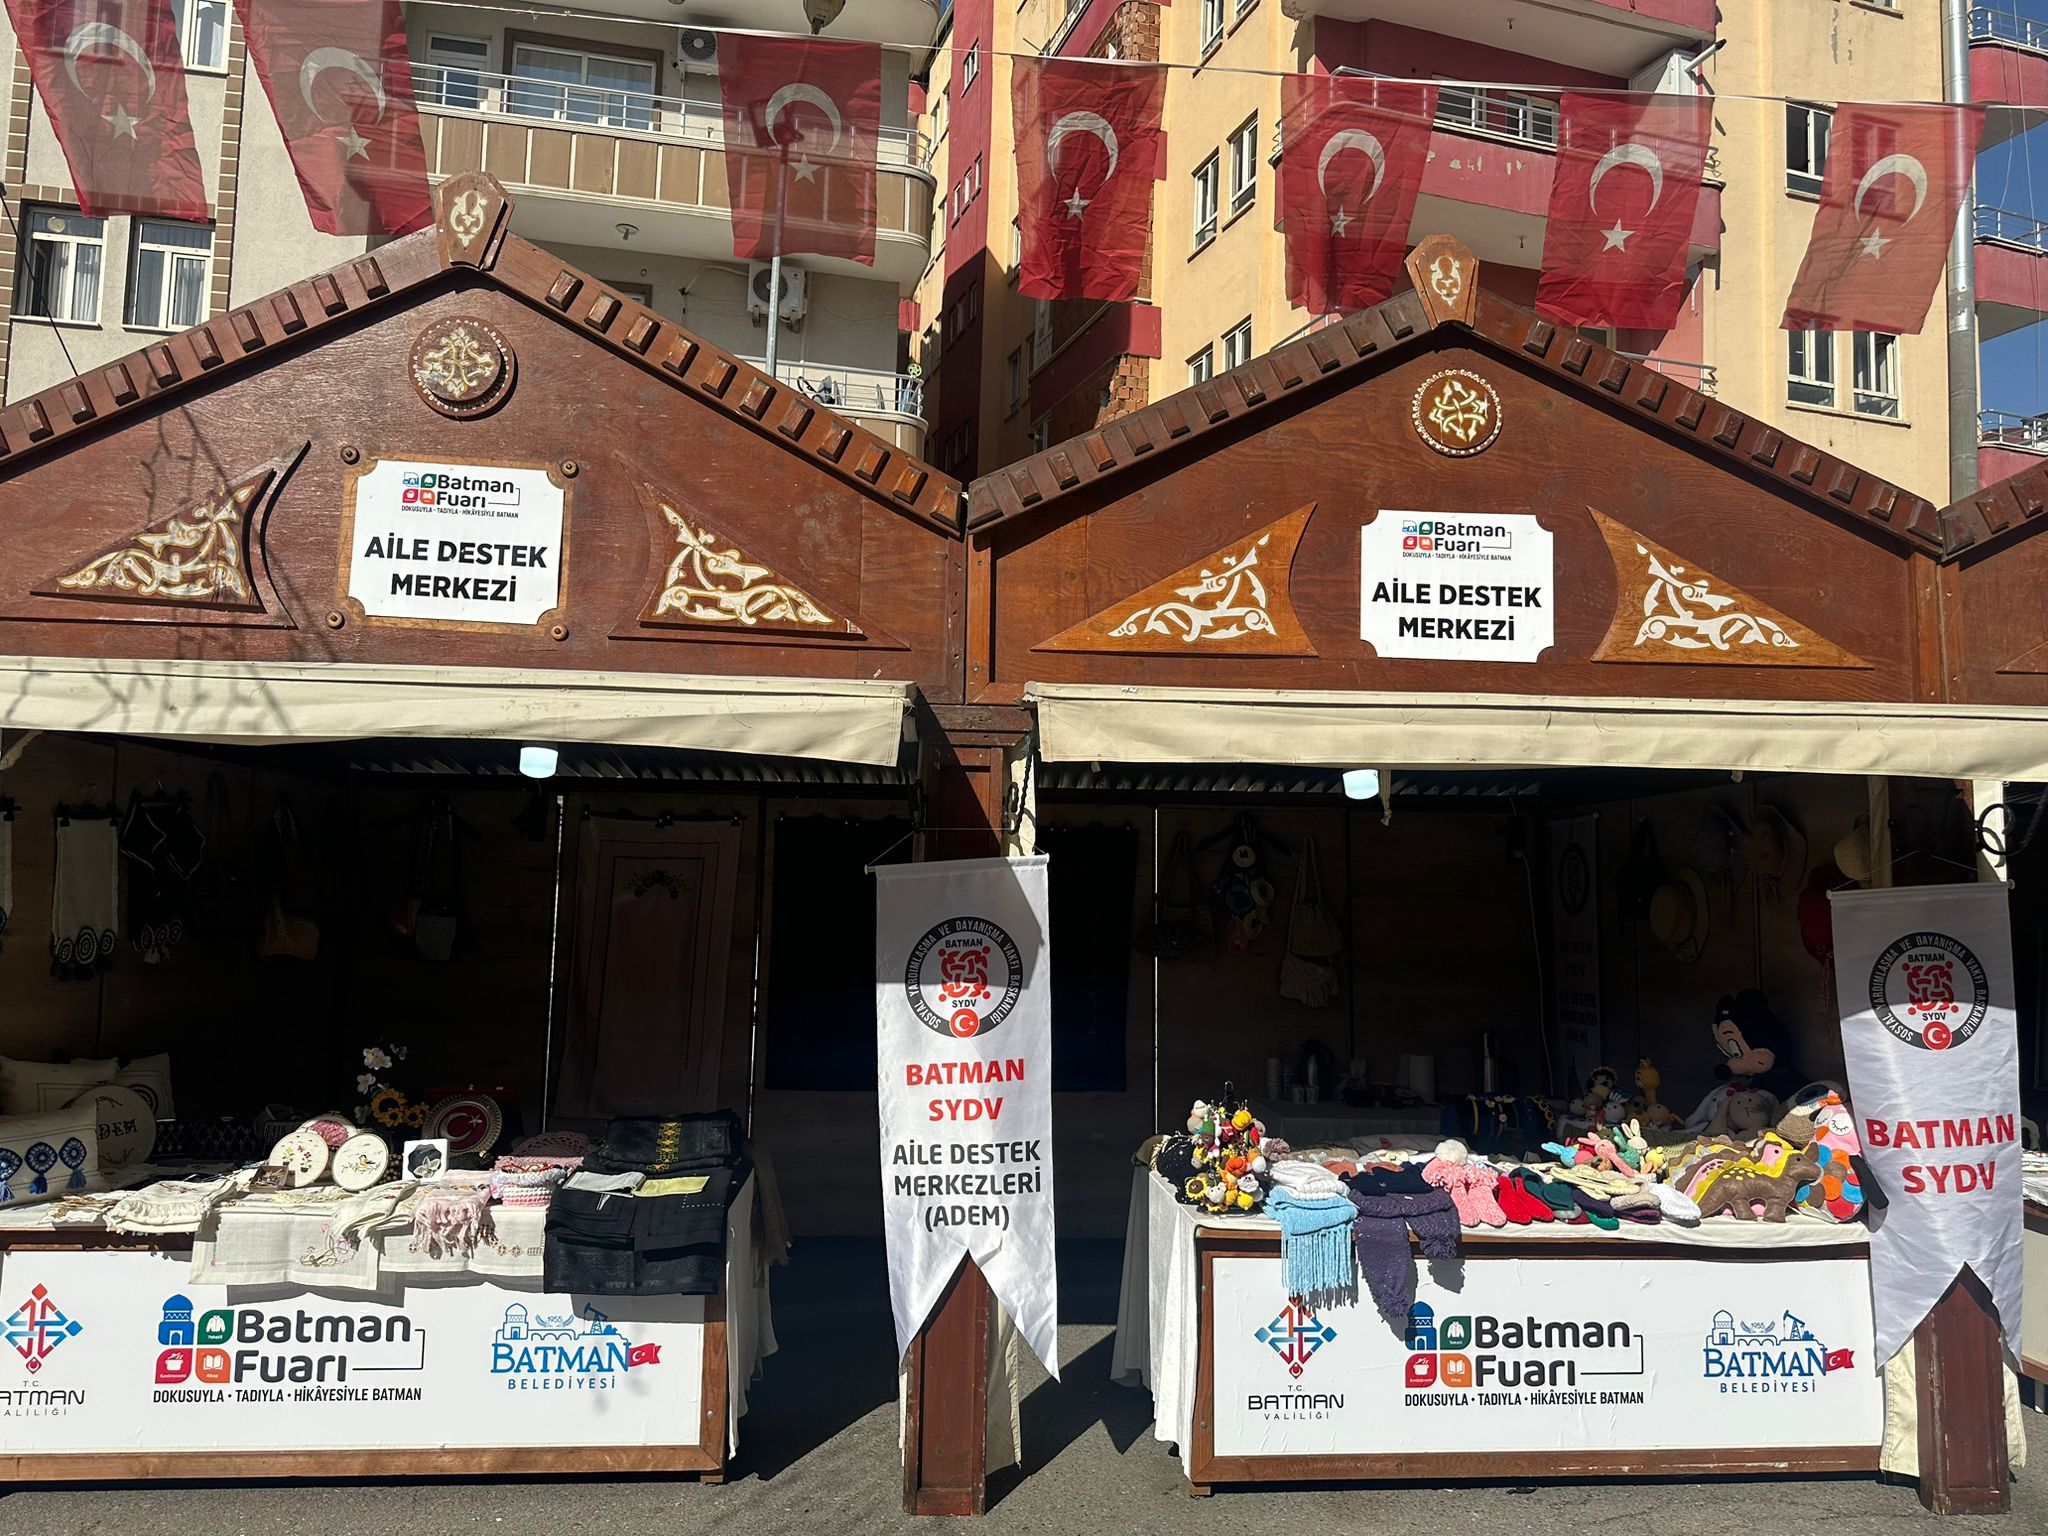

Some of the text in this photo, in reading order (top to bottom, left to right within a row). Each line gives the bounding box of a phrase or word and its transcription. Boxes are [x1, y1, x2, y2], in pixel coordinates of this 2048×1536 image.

[437, 474, 514, 494] Batman
[436, 491, 486, 508] Fuarı
[496, 511, 519, 519] BATMAN
[1434, 521, 1506, 538] Batman
[364, 532, 549, 568] AİLE DESTEK
[1434, 537, 1480, 552] Fuarı
[391, 573, 517, 602] MERKEZİ
[1372, 577, 1542, 608] AİLE DESTEK
[1399, 616, 1515, 641] MERKEZİ
[945, 938, 983, 948] BATMAN
[1908, 953, 1945, 963] BATMAN
[914, 999, 942, 1029] SOSYAL
[939, 923, 952, 936] VE
[1003, 942, 1019, 970] VAKFI
[1882, 1012, 1914, 1042] SOSYAL
[1899, 939, 1912, 951] VE
[1965, 958, 1984, 984] VAKFI
[952, 999, 977, 1008] SYDV
[1922, 1012, 1946, 1021] SYDV
[906, 1058, 1025, 1086] BATMAN
[928, 1097, 1003, 1121] SYDV
[96, 1119, 138, 1140] DEM
[1865, 1113, 2015, 1149] BATMAN
[893, 1139, 1041, 1165] AİLE DESTEK
[894, 1166, 1041, 1196] MERKEZLERİ
[1901, 1160, 1996, 1194] SYDV
[925, 1204, 1010, 1233] (ADEM)
[236, 1309, 411, 1344] Batman
[1475, 1315, 1631, 1348] Batman
[234, 1349, 347, 1383] Fuarı
[490, 1342, 632, 1374] BATMAN
[1703, 1348, 1828, 1377] BATMAN
[508, 1375, 616, 1390] BELEDİYESİ
[1476, 1355, 1576, 1387] Fuarı
[0, 1390, 85, 1406] ATMAN
[153, 1385, 422, 1403] DOKUSUYLA TADIYLA HİKÂYESİYLE BATMAN
[1405, 1389, 1644, 1406] DOKUSUYLA TADIYLA HİKÂYESİYLE BATMAN
[1720, 1380, 1816, 1393] BELEDİYESİ
[4, 1408, 67, 1417] ALİLİĞİ
[1248, 1394, 1344, 1410] BATMAN
[1264, 1411, 1329, 1420] VALİLİĞİ
